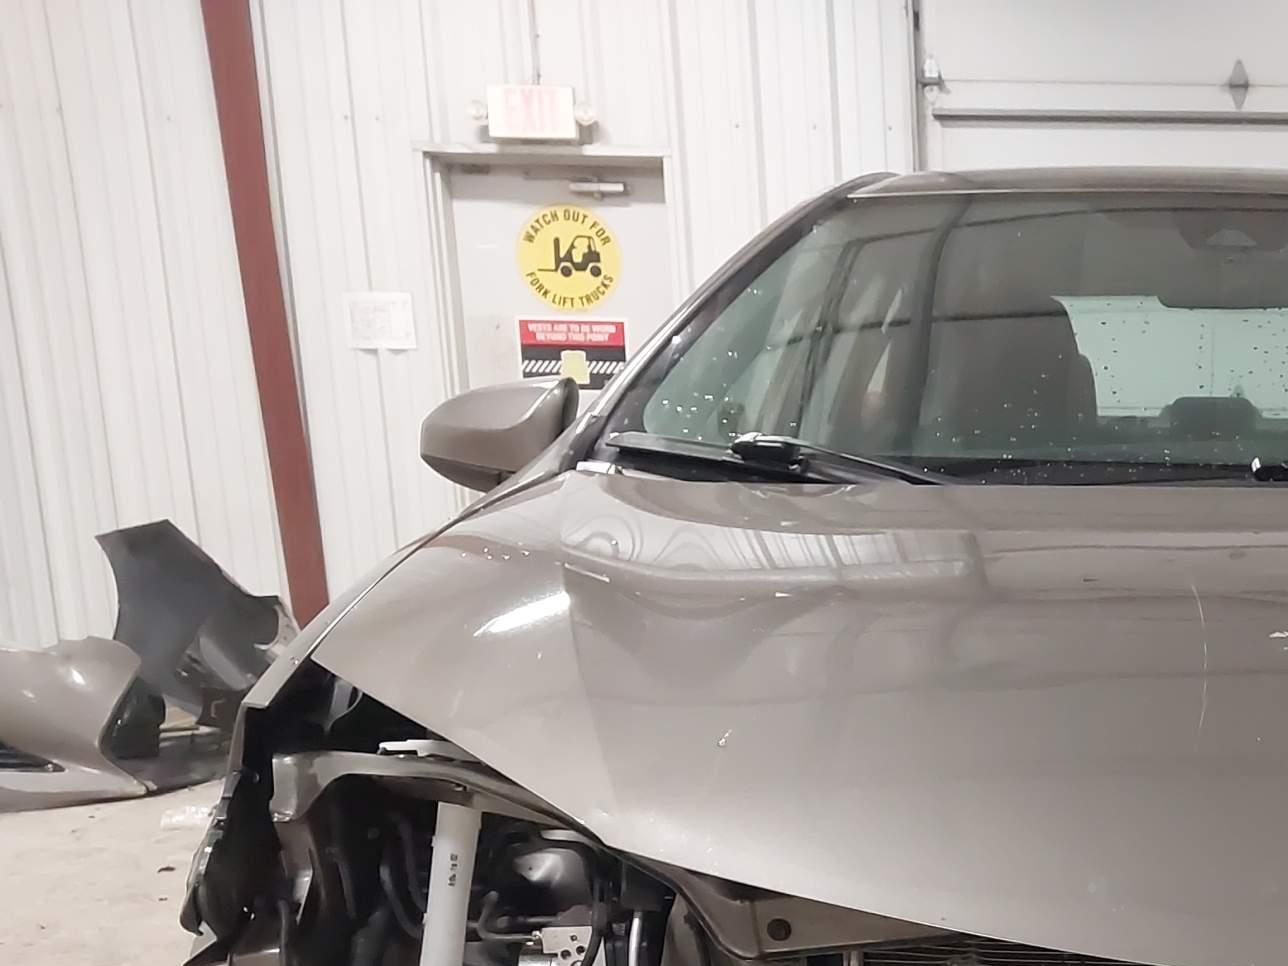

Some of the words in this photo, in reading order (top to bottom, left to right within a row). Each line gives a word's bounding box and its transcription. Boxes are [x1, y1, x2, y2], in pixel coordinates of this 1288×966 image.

[503, 88, 559, 132] EXIT
[523, 210, 559, 244] WATCH
[563, 208, 589, 225] OUT
[588, 221, 611, 247] FOR
[525, 271, 551, 299] FORK
[551, 293, 575, 309] LIFT
[578, 274, 614, 307] TRUCKS
